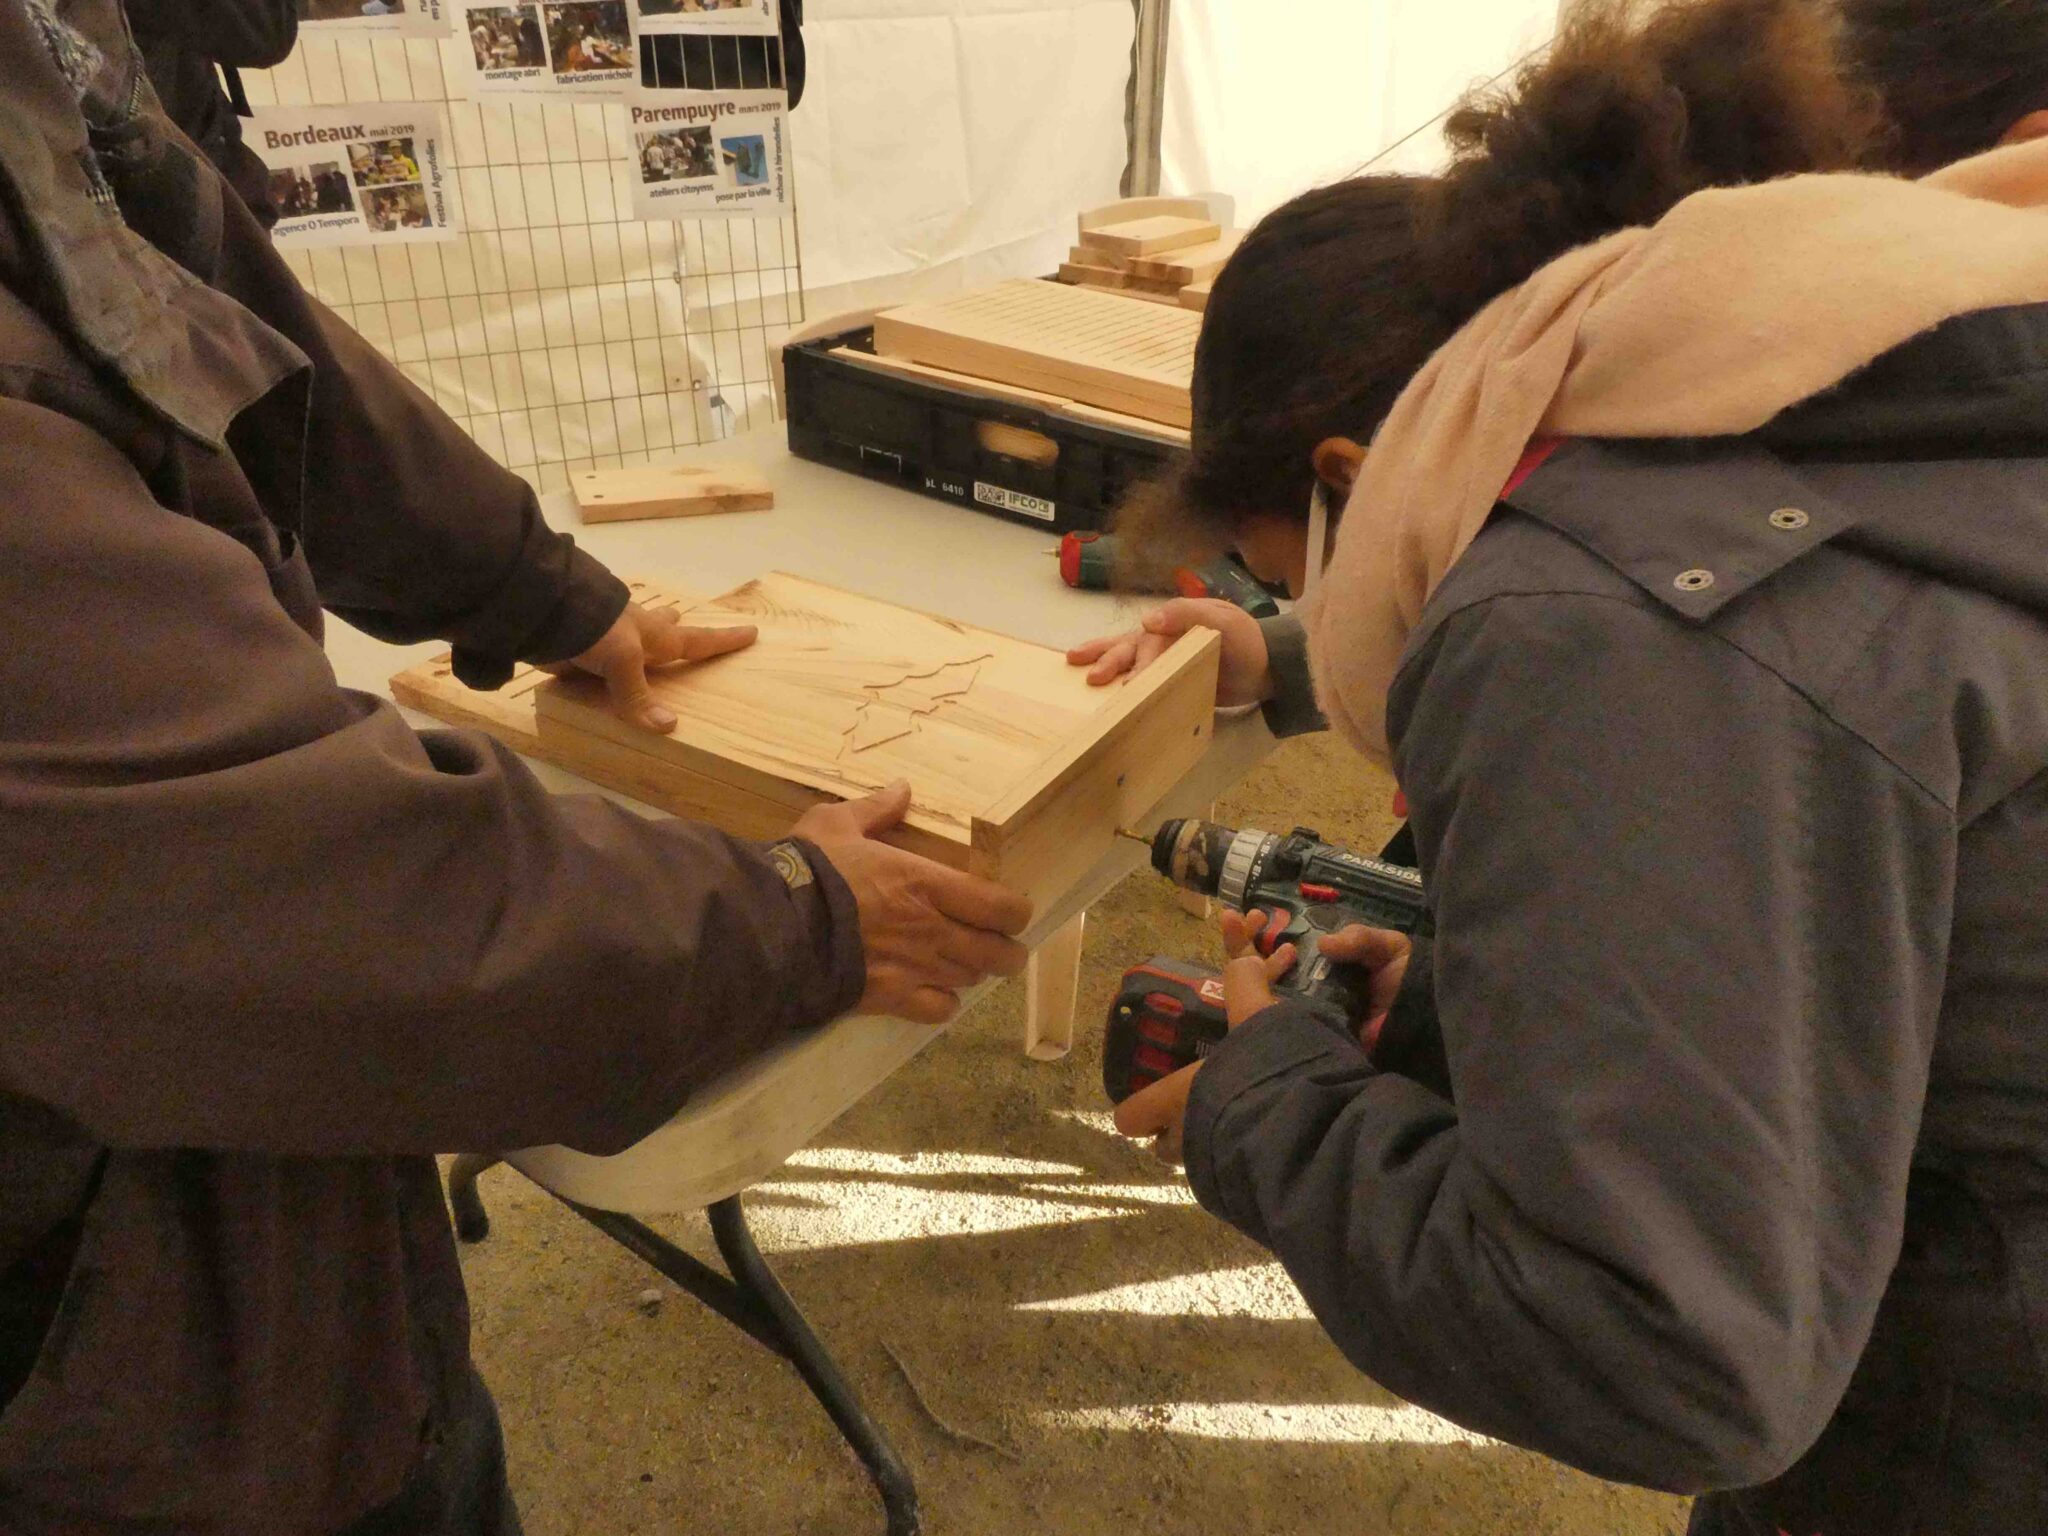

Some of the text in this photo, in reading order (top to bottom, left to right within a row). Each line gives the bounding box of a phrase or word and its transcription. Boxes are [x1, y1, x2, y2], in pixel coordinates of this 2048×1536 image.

[485, 69, 541, 81] montage abri
[556, 69, 633, 85] fabrication nichoir
[631, 102, 782, 124] Parempuyre mars 2019
[264, 124, 415, 149] Bordeaux mai 2019
[427, 139, 447, 228] Festival Agrofolies
[649, 184, 714, 198] ateliers citoyens
[715, 187, 772, 204] pose par la ville
[273, 216, 360, 237] agence O Tempora
[1009, 491, 1038, 509] IFCO
